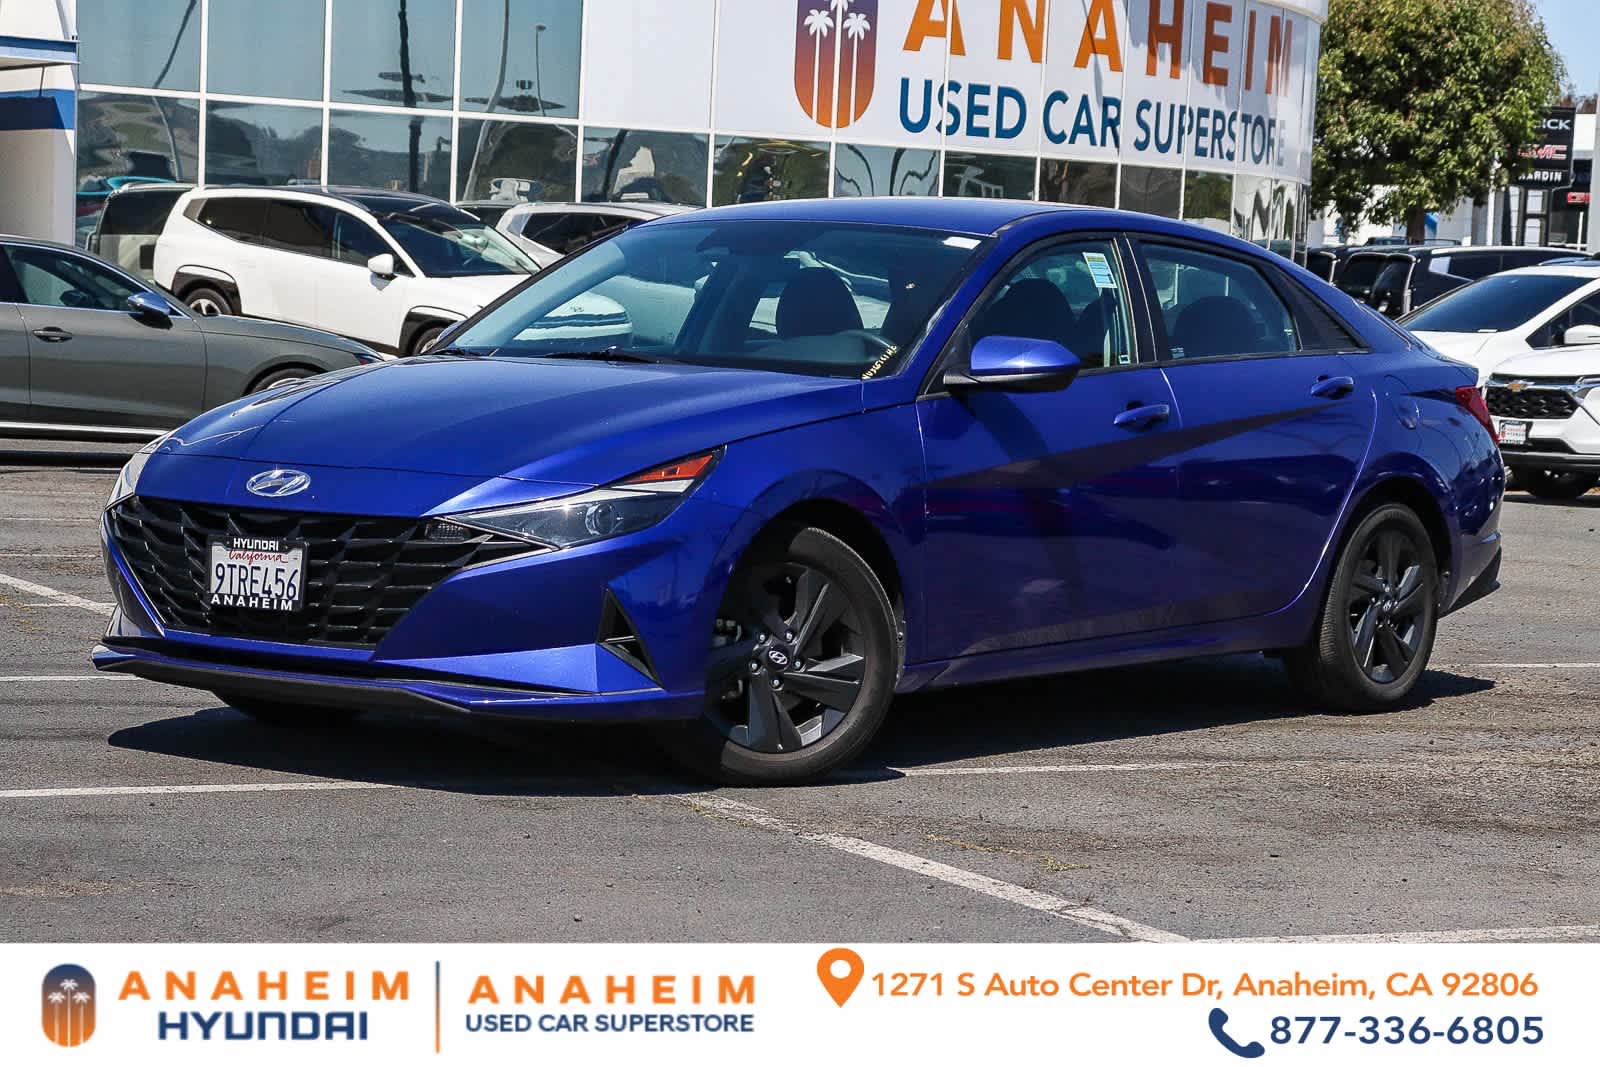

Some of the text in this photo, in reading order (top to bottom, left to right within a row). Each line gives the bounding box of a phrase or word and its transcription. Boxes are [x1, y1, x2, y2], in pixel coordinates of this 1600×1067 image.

[903, 0, 1292, 97] ANAHEIM
[899, 77, 1286, 167] USED CAR SUPERSTORE
[229, 549, 288, 566] California
[233, 537, 279, 551] HYUNDAI
[215, 563, 299, 600] 9TRE456
[210, 593, 292, 611] ANAHEIM
